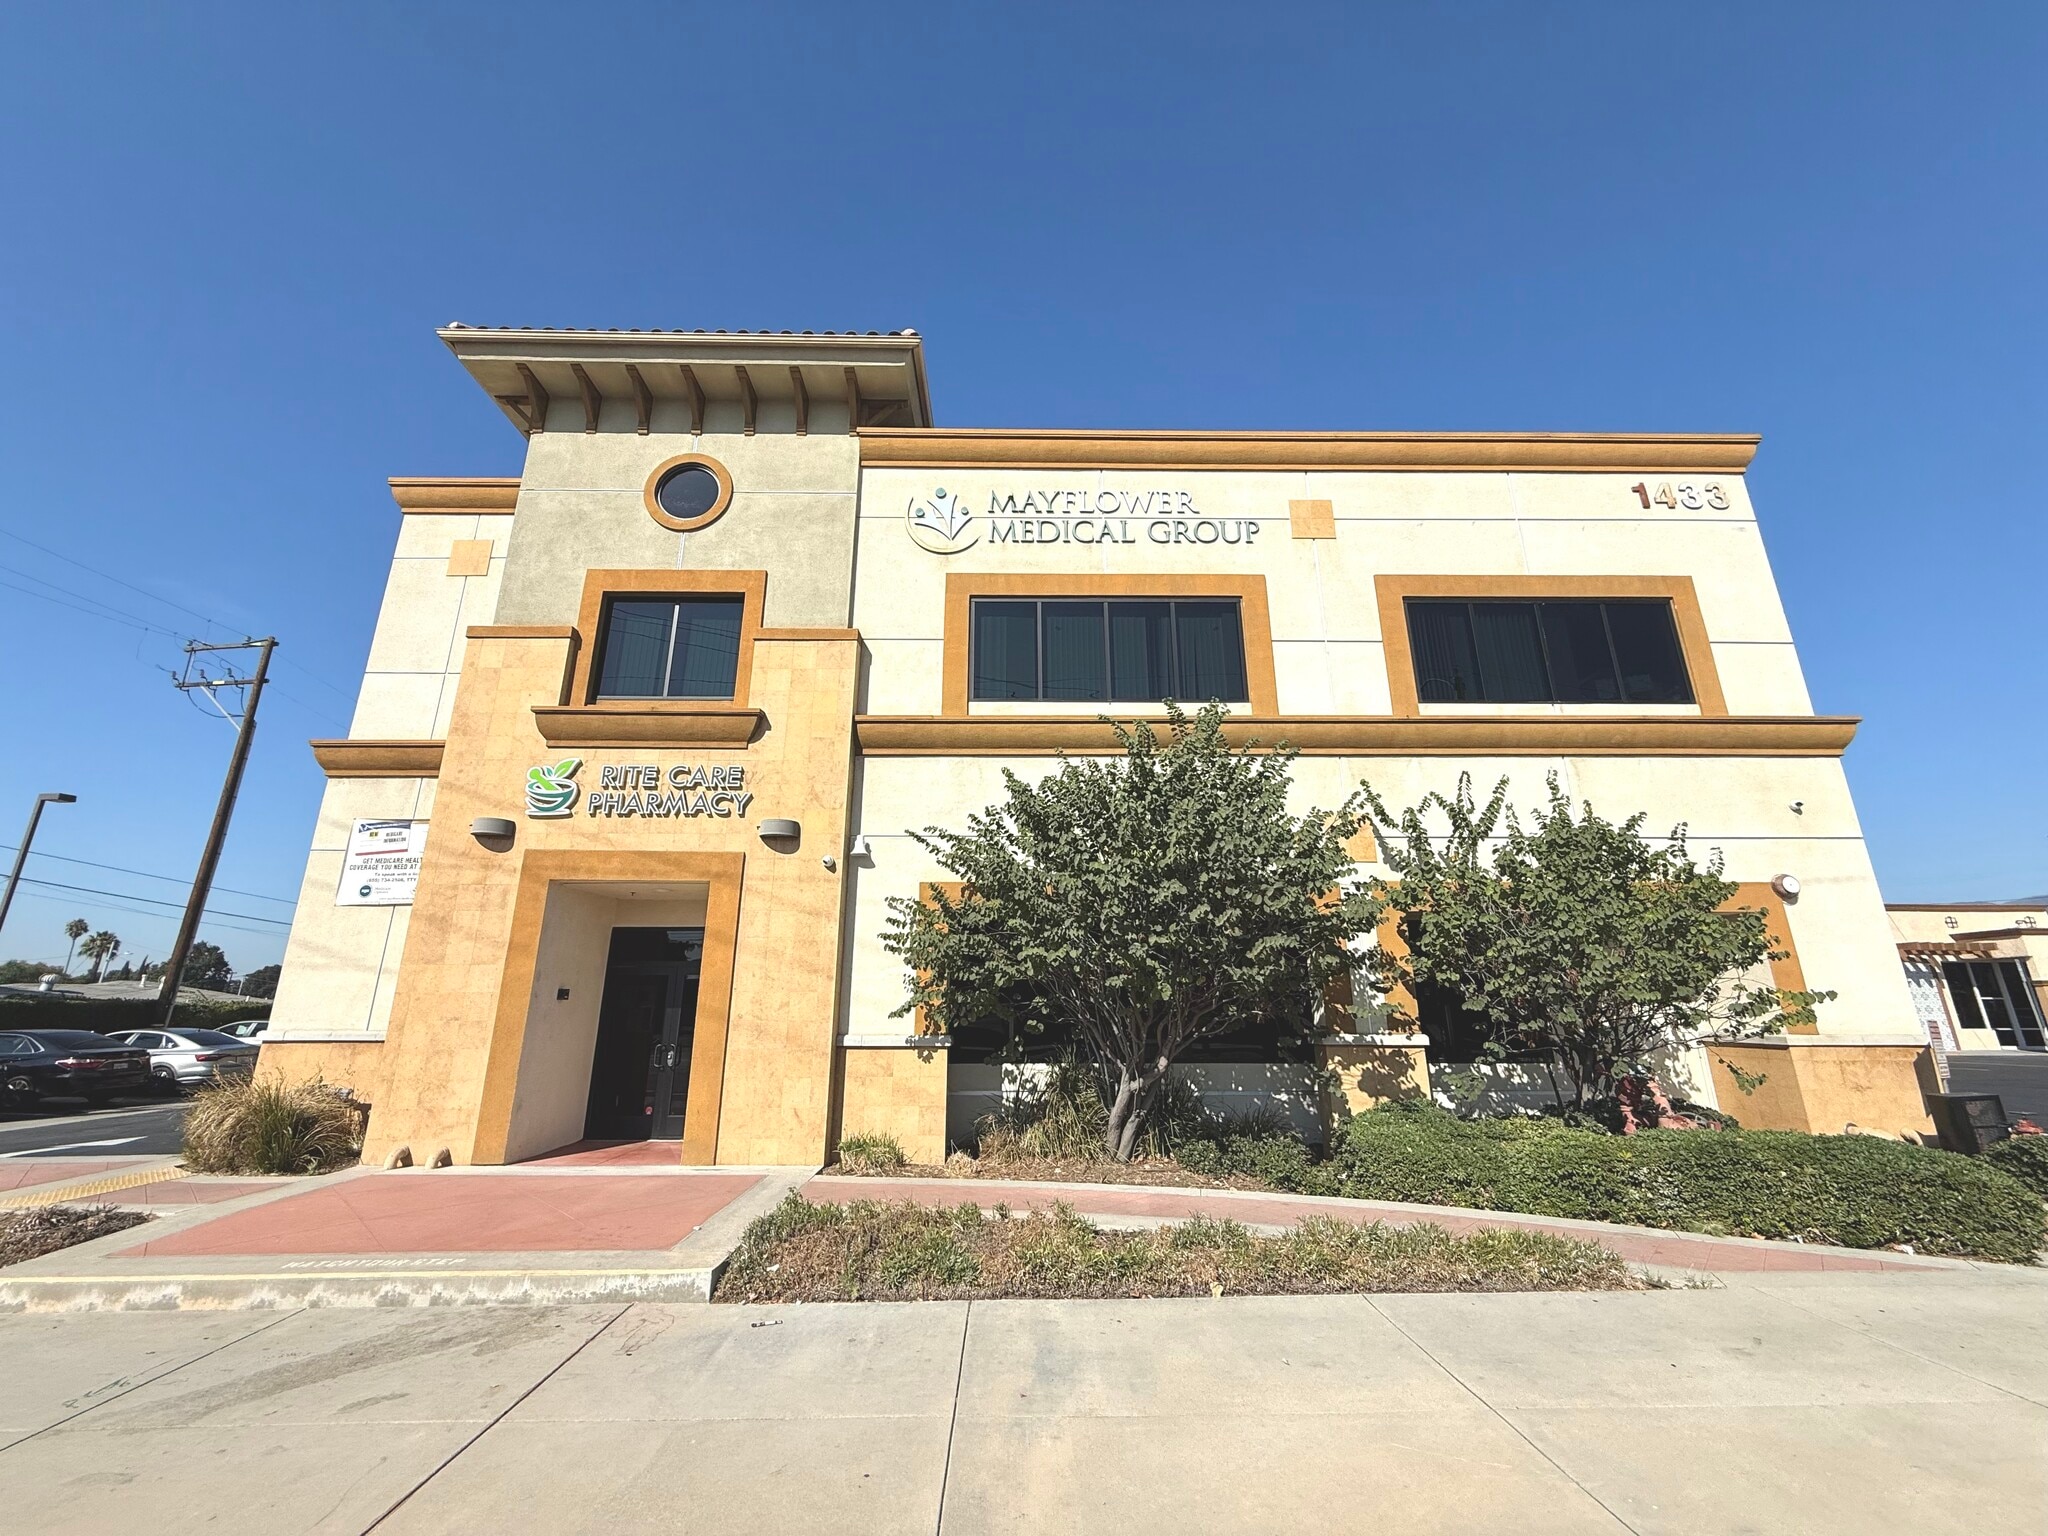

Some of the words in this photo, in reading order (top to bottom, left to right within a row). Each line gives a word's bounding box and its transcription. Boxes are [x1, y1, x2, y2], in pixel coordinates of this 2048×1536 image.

[987, 490, 1200, 514] MAYFLOWER
[1630, 482, 1731, 510] 1433
[987, 519, 1136, 544] MEDICAL
[1146, 519, 1260, 545] GROUP
[601, 764, 659, 789] RITE
[667, 764, 743, 790] CARE
[587, 790, 753, 817] PHARMACY
[410, 1258, 467, 1266] STEP
